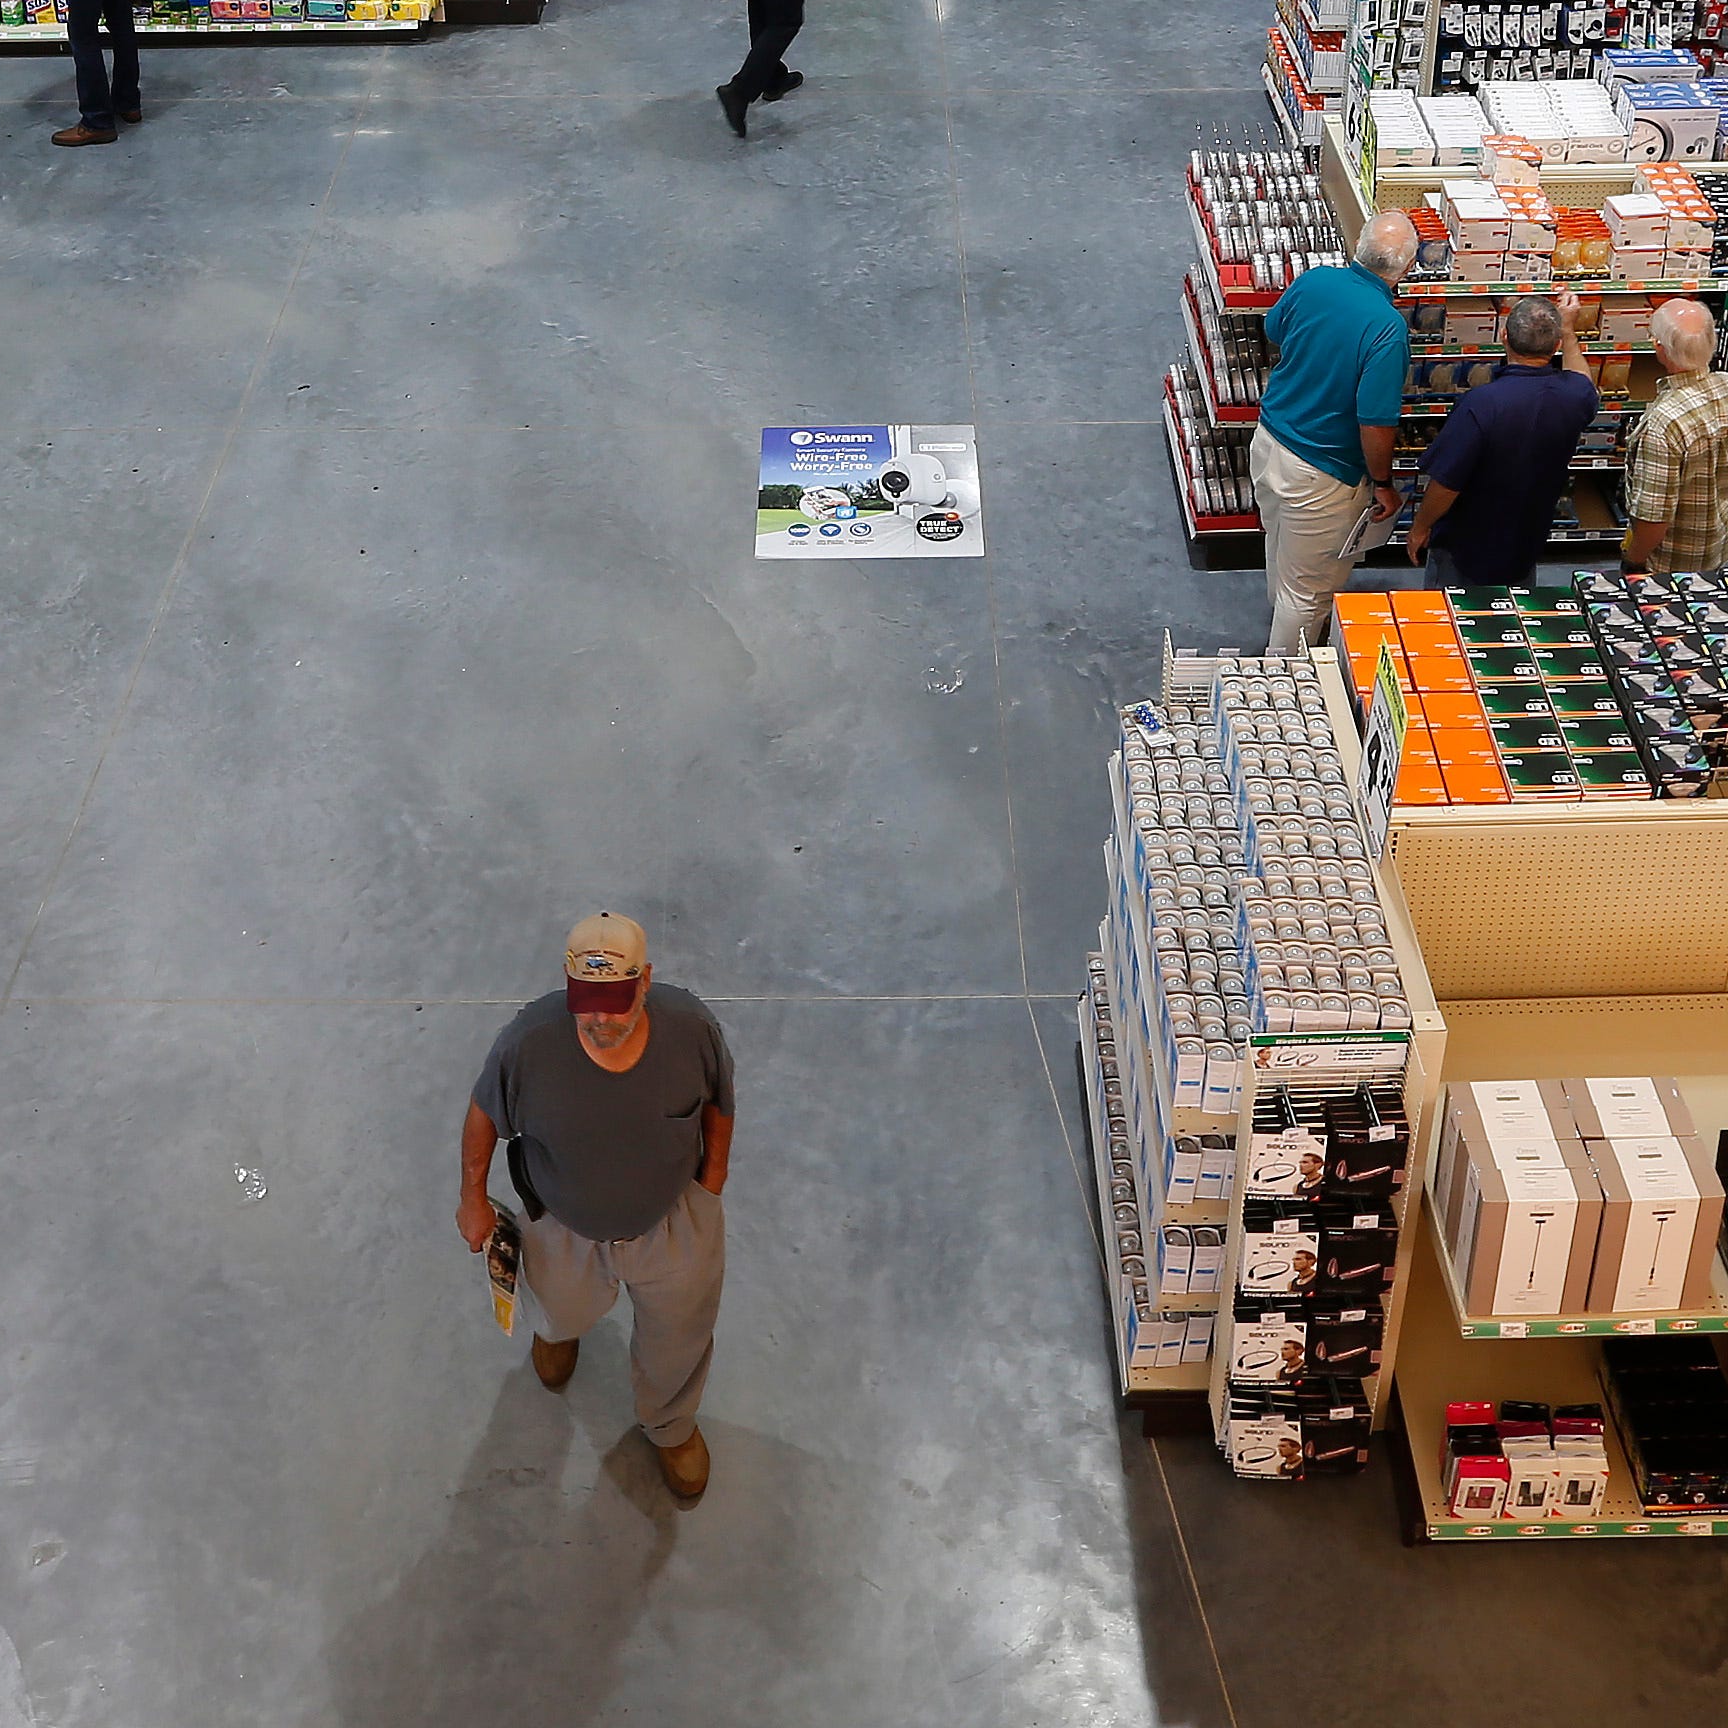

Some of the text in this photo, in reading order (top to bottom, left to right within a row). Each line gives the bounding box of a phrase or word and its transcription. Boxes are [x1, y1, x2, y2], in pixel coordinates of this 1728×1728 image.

[812, 432, 873, 443] Swann
[795, 450, 868, 462] Wire-Free
[790, 460, 872, 473] Worry-Free
